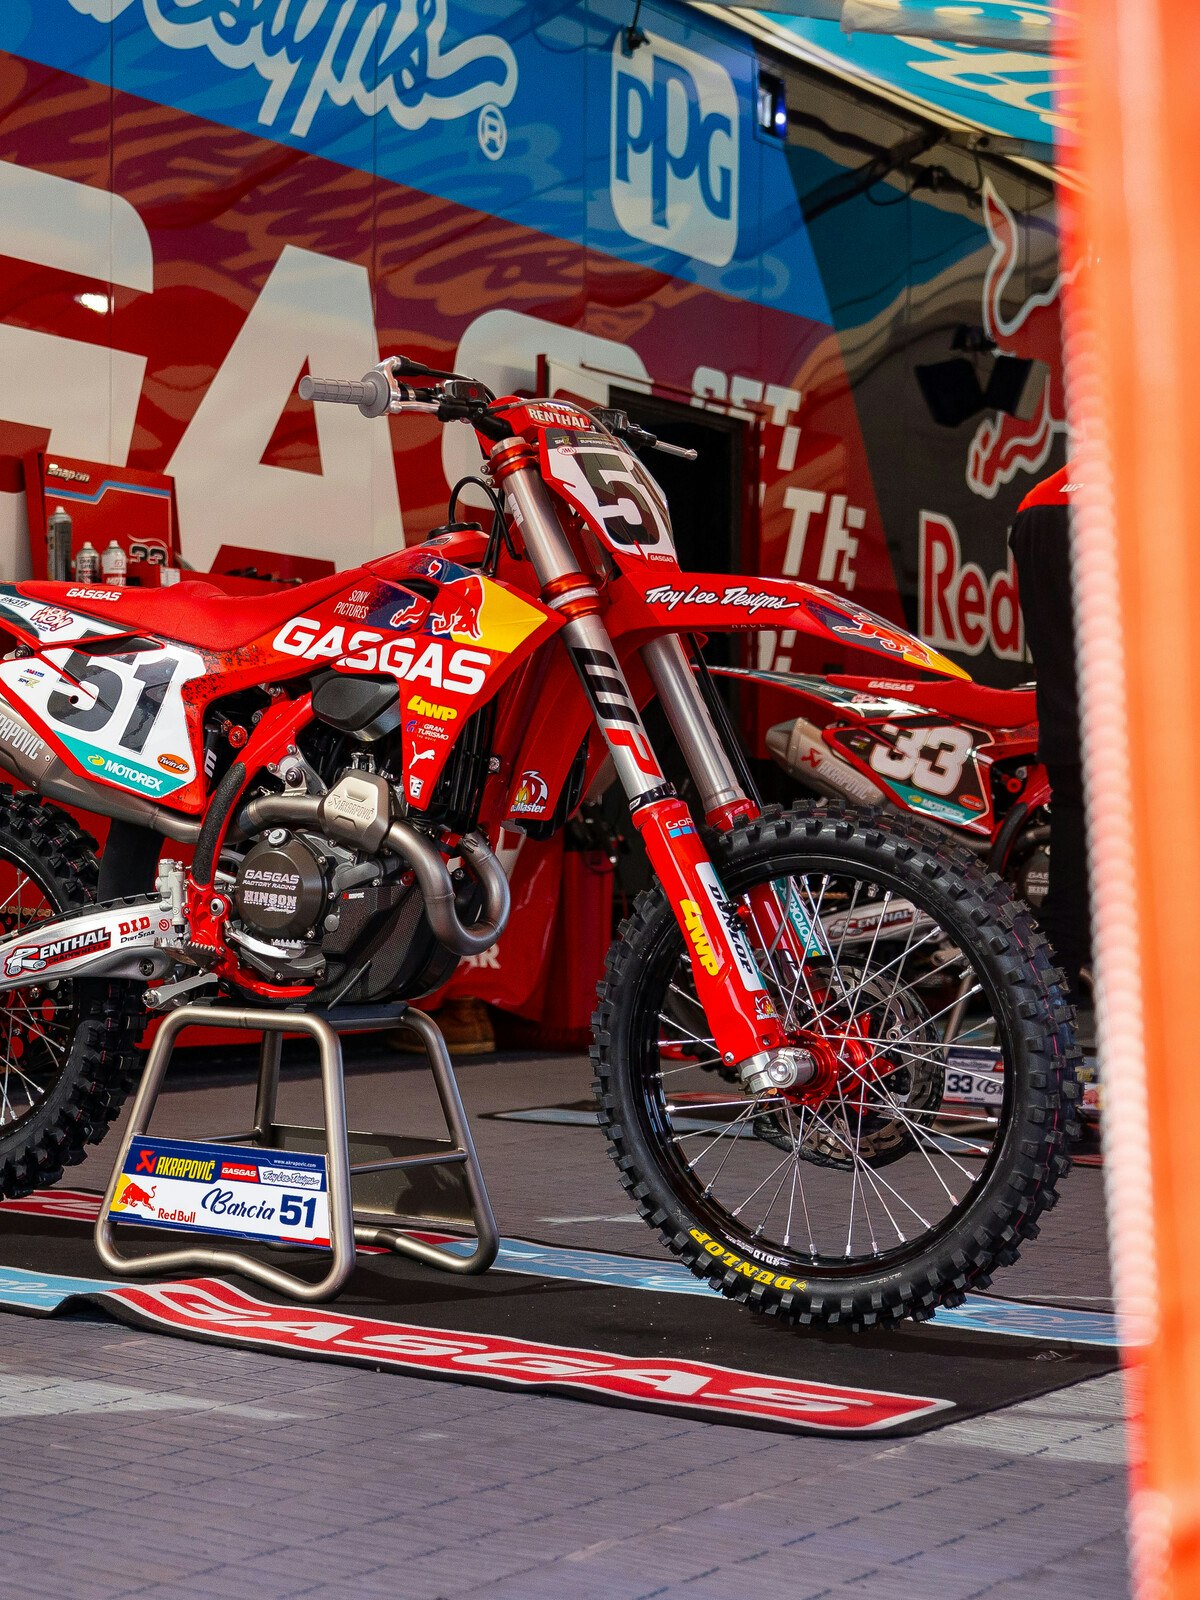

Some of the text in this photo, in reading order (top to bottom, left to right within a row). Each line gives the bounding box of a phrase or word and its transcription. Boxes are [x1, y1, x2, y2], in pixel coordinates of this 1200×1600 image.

[615, 55, 732, 229] PPG
[528, 408, 590, 429] RENTHAL
[650, 555, 674, 563] GASGAS
[66, 588, 121, 601] GASGAS
[918, 510, 1026, 662] Red
[348, 590, 370, 604] SONY
[646, 586, 800, 614] Troy Lee Designs
[333, 602, 369, 619] PICTURES
[272, 617, 491, 695] GASGAS
[47, 630, 180, 754] 51
[868, 681, 915, 692] GASGAS
[407, 695, 458, 721] 4WP
[417, 728, 450, 741] TURISMO
[424, 723, 445, 733] GRAN
[870, 724, 974, 796] 33
[105, 760, 164, 791] MOTOREX
[243, 880, 297, 891] FACTORY RACING
[245, 869, 300, 884] GASGAS
[244, 890, 297, 906] HINSON
[947, 1074, 973, 1094] 33
[221, 1166, 257, 1178] GASGAS
[201, 1187, 276, 1221] Barcia
[279, 1194, 317, 1229] 51
[158, 1208, 196, 1224] Red Bull
[690, 1227, 798, 1291] DUNLOP
[150, 1284, 874, 1413] GASGAS
